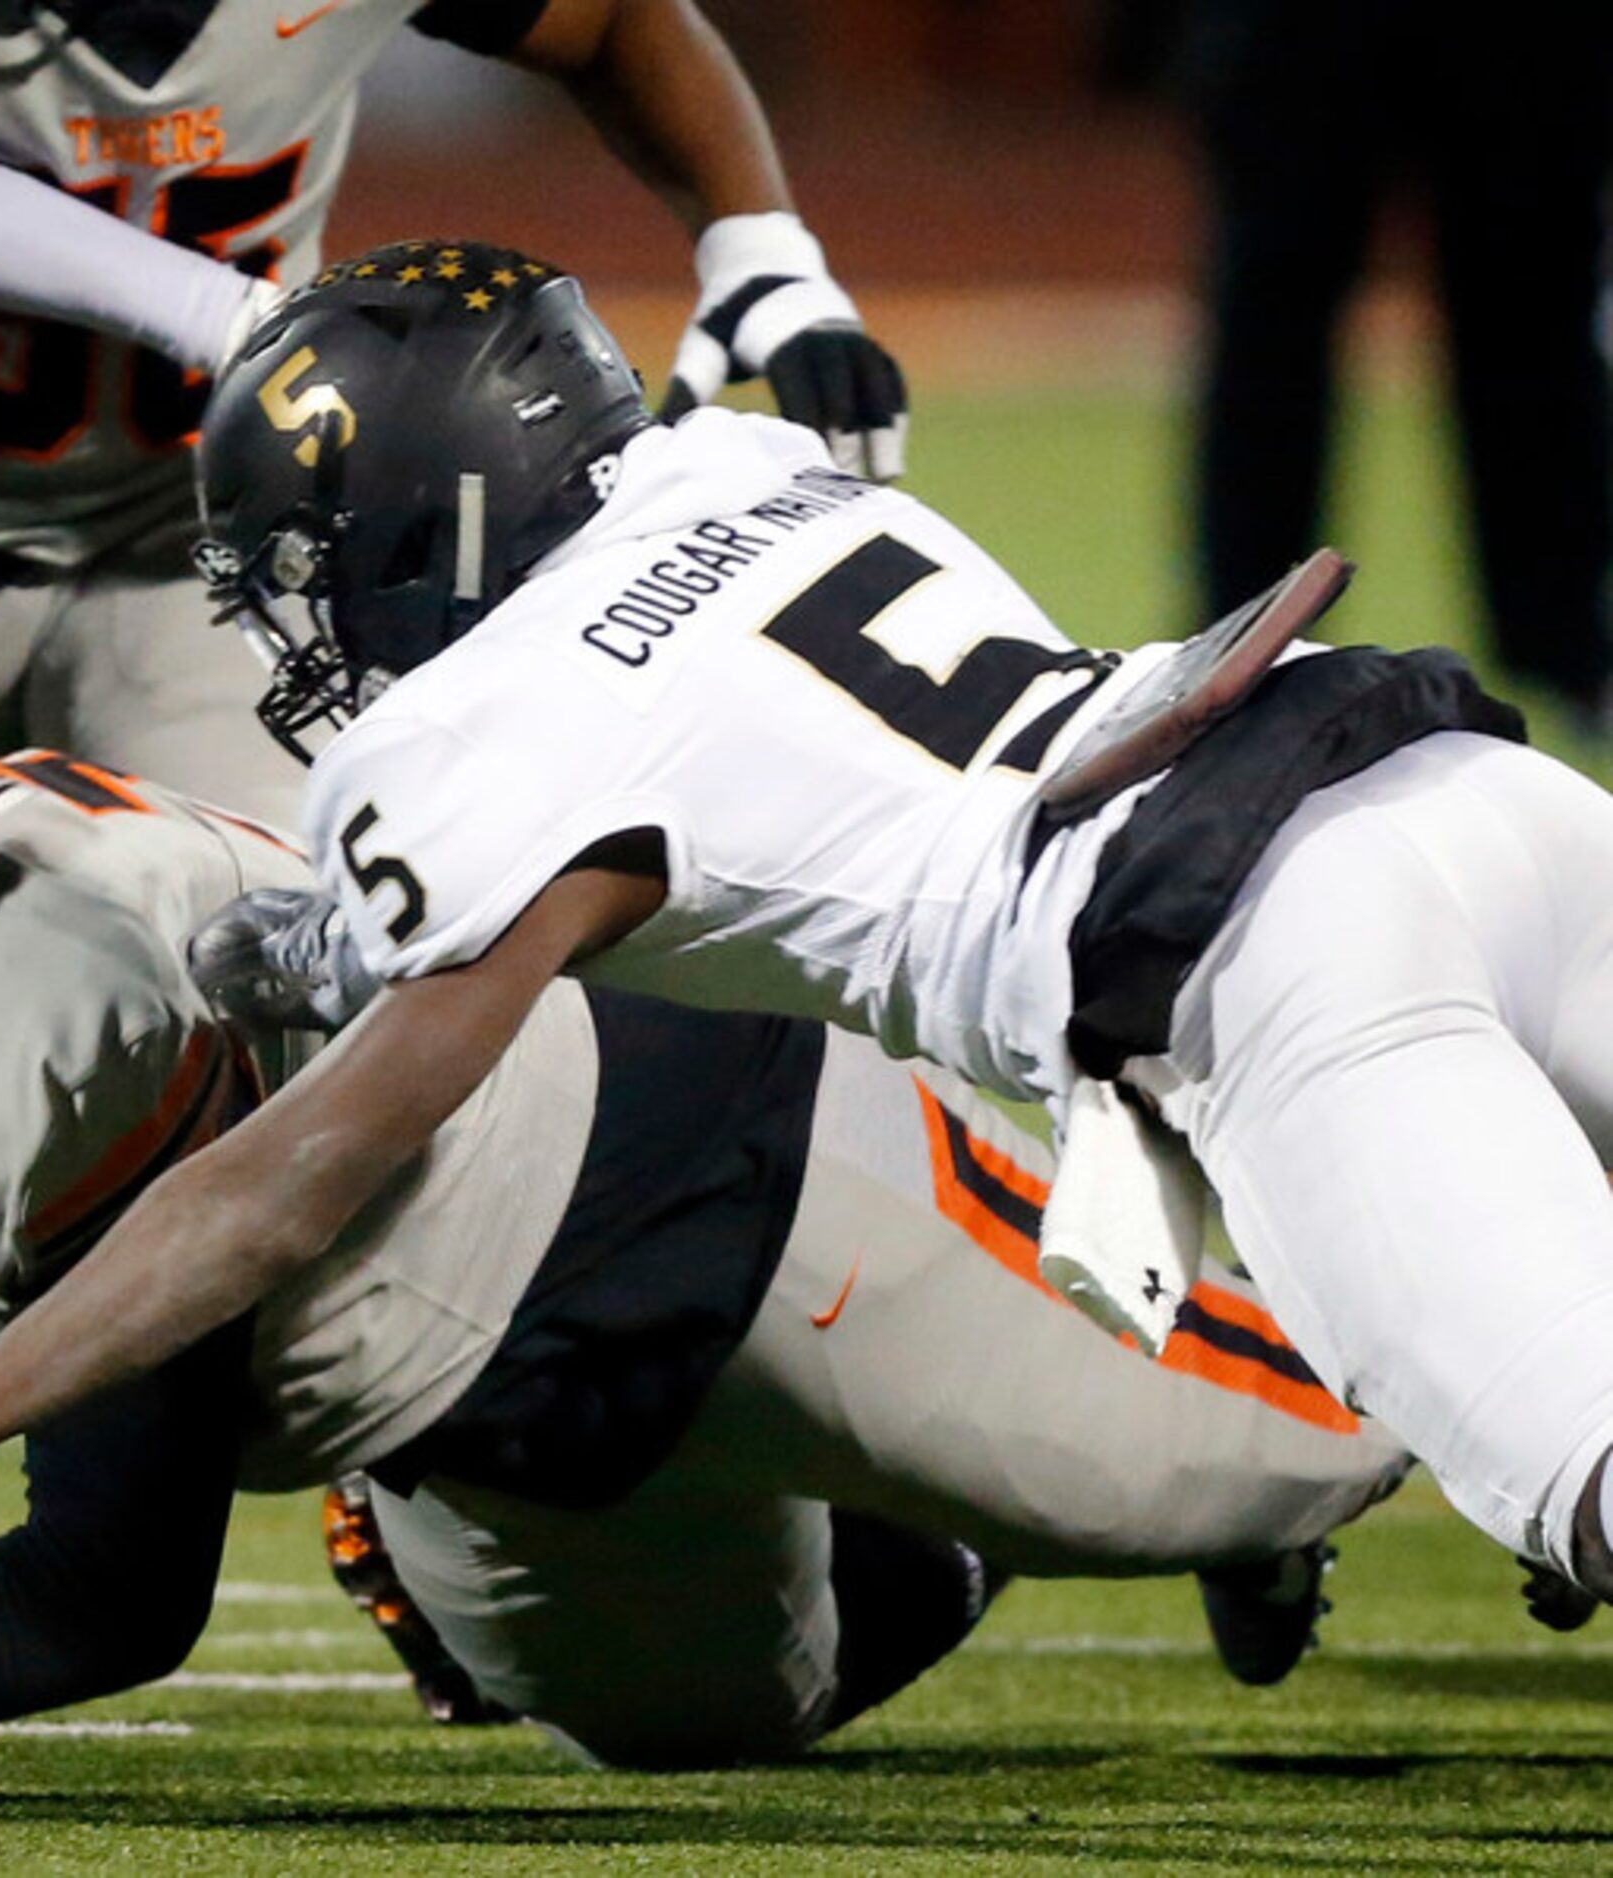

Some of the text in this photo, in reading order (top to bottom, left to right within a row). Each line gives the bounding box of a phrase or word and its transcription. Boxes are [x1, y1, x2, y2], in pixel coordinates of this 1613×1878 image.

[256, 345, 358, 468] 5
[581, 519, 775, 669] COUGAR
[752, 530, 1121, 780] 5
[337, 800, 428, 948] 5
